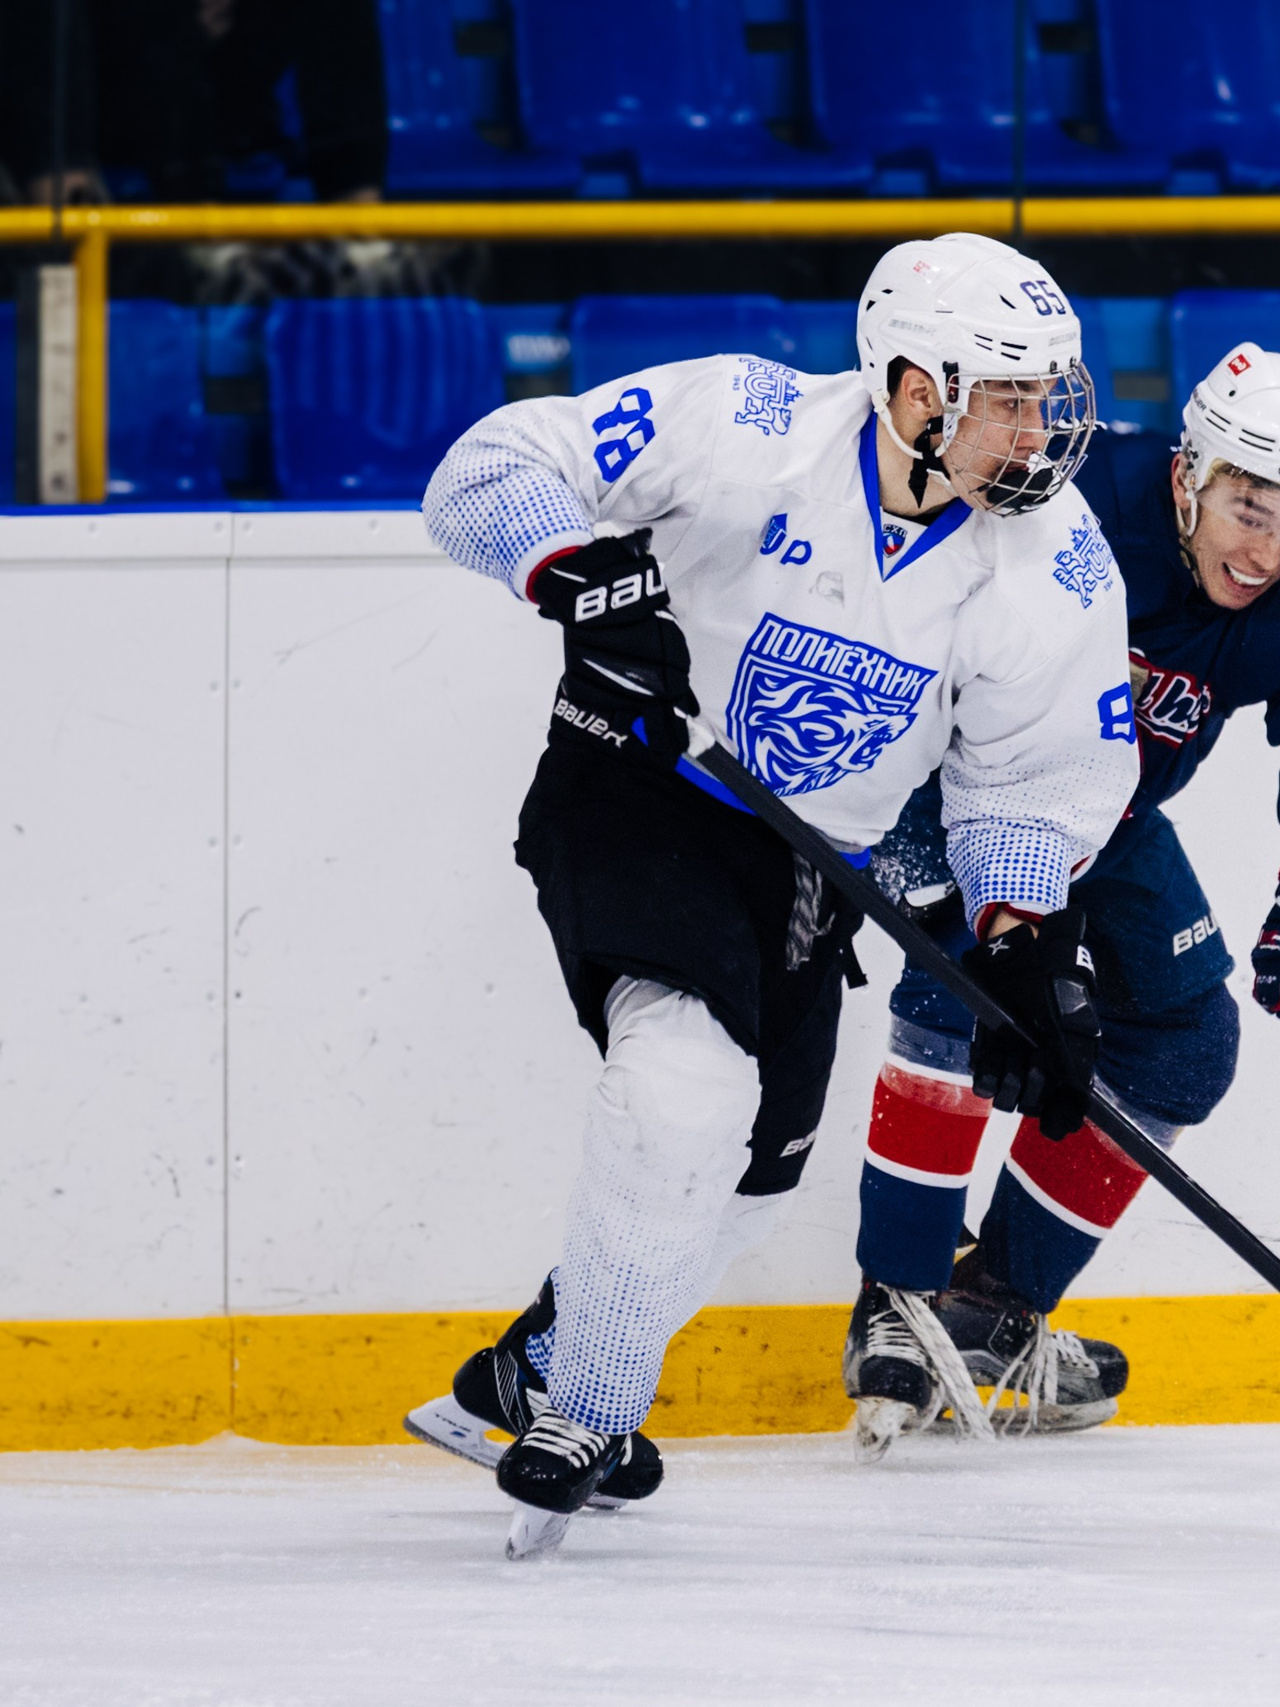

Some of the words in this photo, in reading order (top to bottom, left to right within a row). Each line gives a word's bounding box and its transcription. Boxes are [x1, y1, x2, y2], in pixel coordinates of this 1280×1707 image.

[1019, 280, 1067, 316] 65
[575, 569, 667, 622] BAU
[751, 619, 930, 700] ПОЛИТЕХНИК
[1173, 915, 1218, 957] BAU
